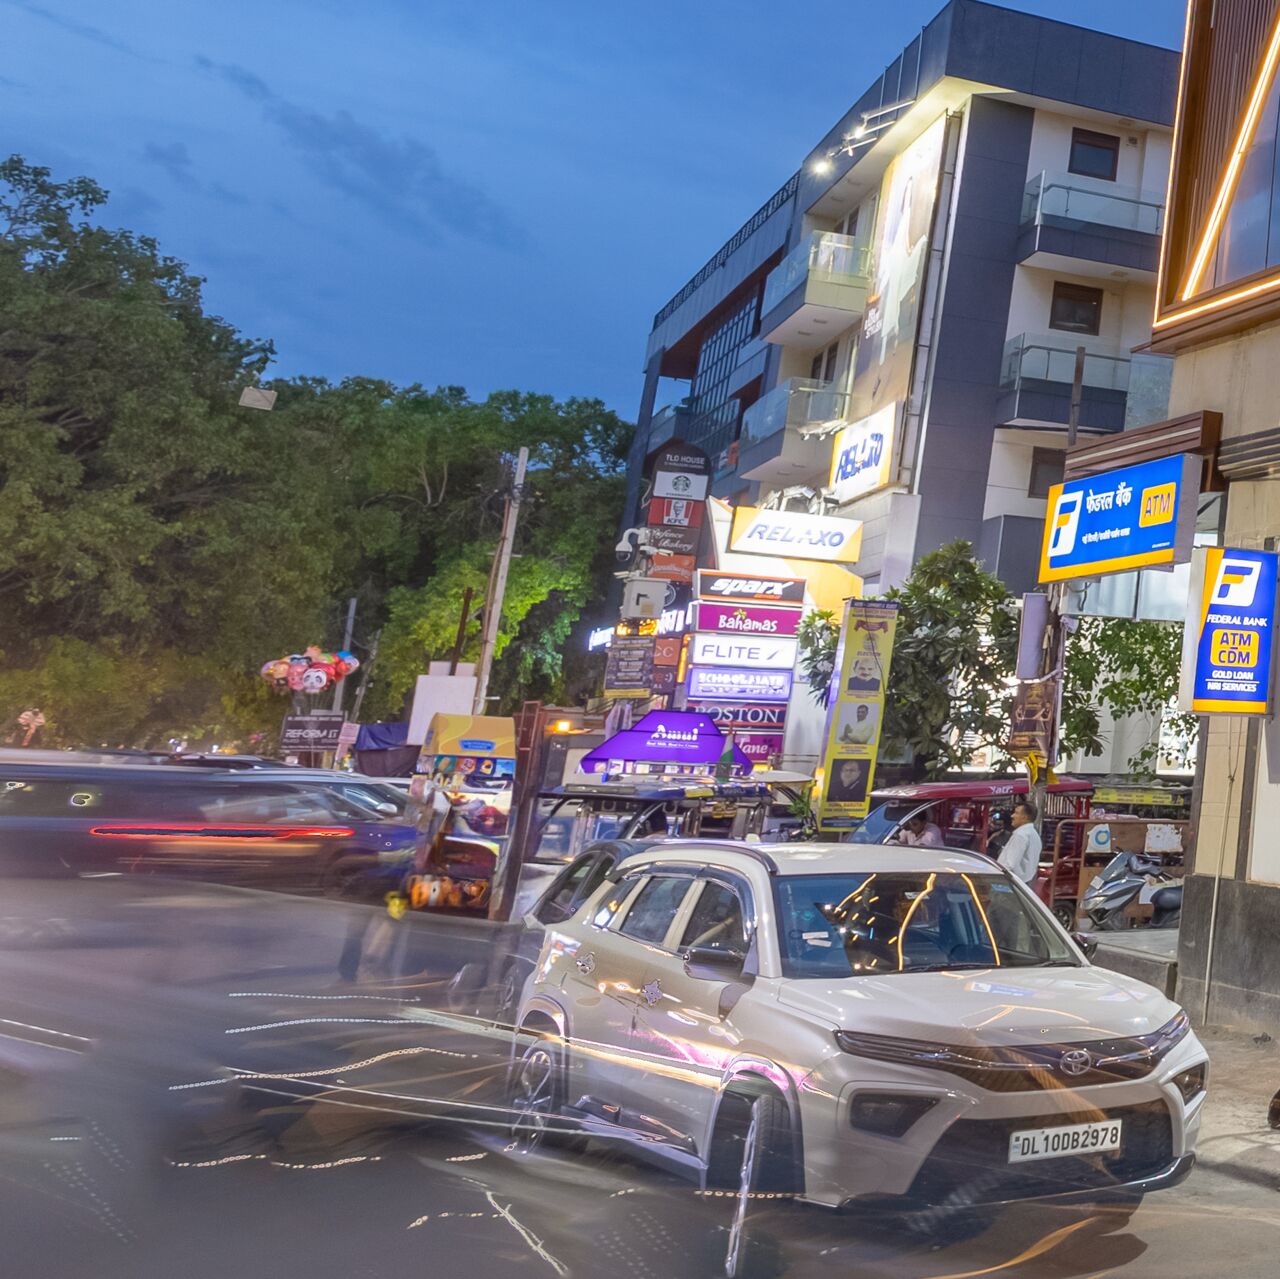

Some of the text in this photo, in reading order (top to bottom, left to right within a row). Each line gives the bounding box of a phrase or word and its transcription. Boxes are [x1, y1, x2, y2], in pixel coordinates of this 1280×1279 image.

[681, 456, 705, 465] HOUSE
[1086, 489, 1115, 513] फेडरल
[1144, 492, 1171, 518] ATM
[710, 578, 794, 595] sparx
[718, 614, 778, 632] Bahamas
[1206, 614, 1268, 627] FEDERAL BANK
[1220, 632, 1252, 647] ATM
[701, 644, 761, 660] FLITE
[1218, 650, 1250, 665] CDM
[1212, 670, 1254, 681] GOLD LOAN
[1207, 682, 1257, 693] NRI SERVICES
[1020, 1126, 1119, 1156] DL10DB2978
